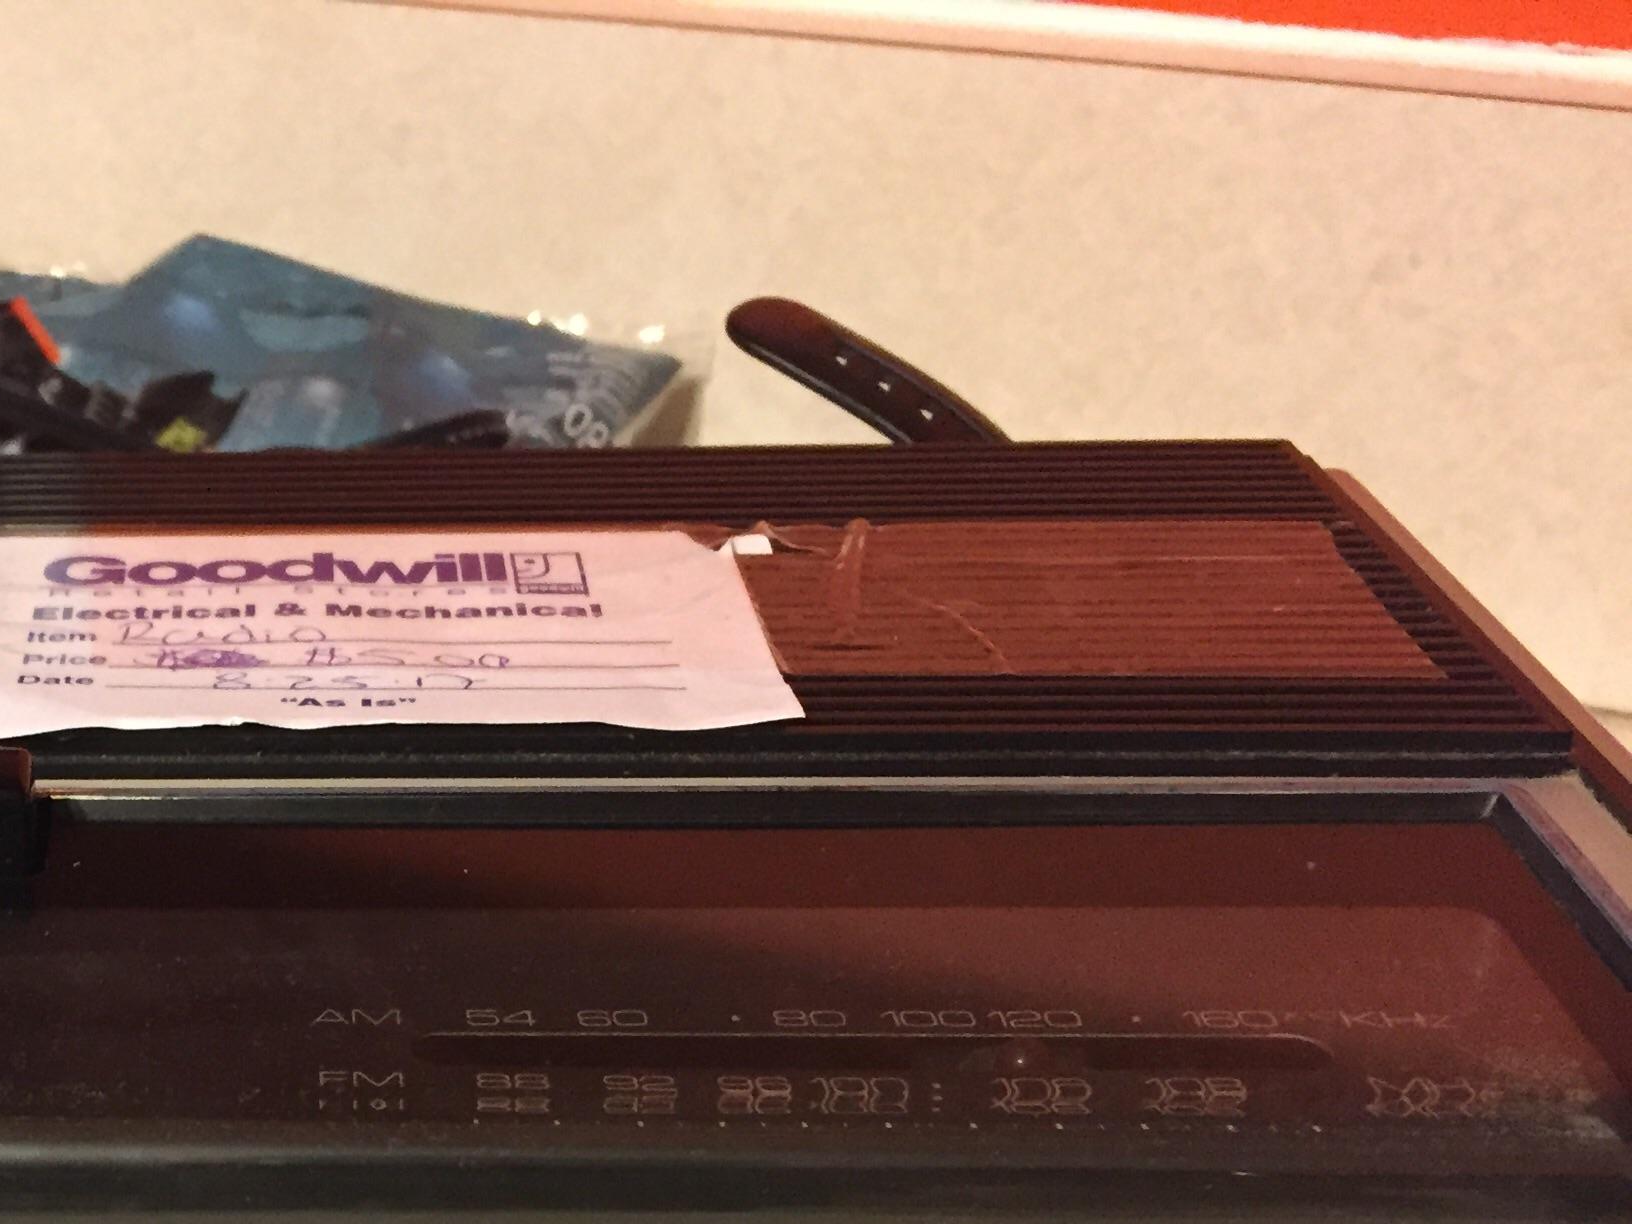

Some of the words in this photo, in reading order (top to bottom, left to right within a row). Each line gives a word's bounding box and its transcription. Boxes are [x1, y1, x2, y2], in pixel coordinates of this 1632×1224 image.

[43, 552, 508, 585] Goodwill
[32, 604, 256, 620] Electrical
[274, 603, 306, 616] &
[325, 603, 603, 618] Mechanical
[27, 631, 97, 642] Item
[23, 653, 107, 665] Price
[17, 674, 94, 685] Date
